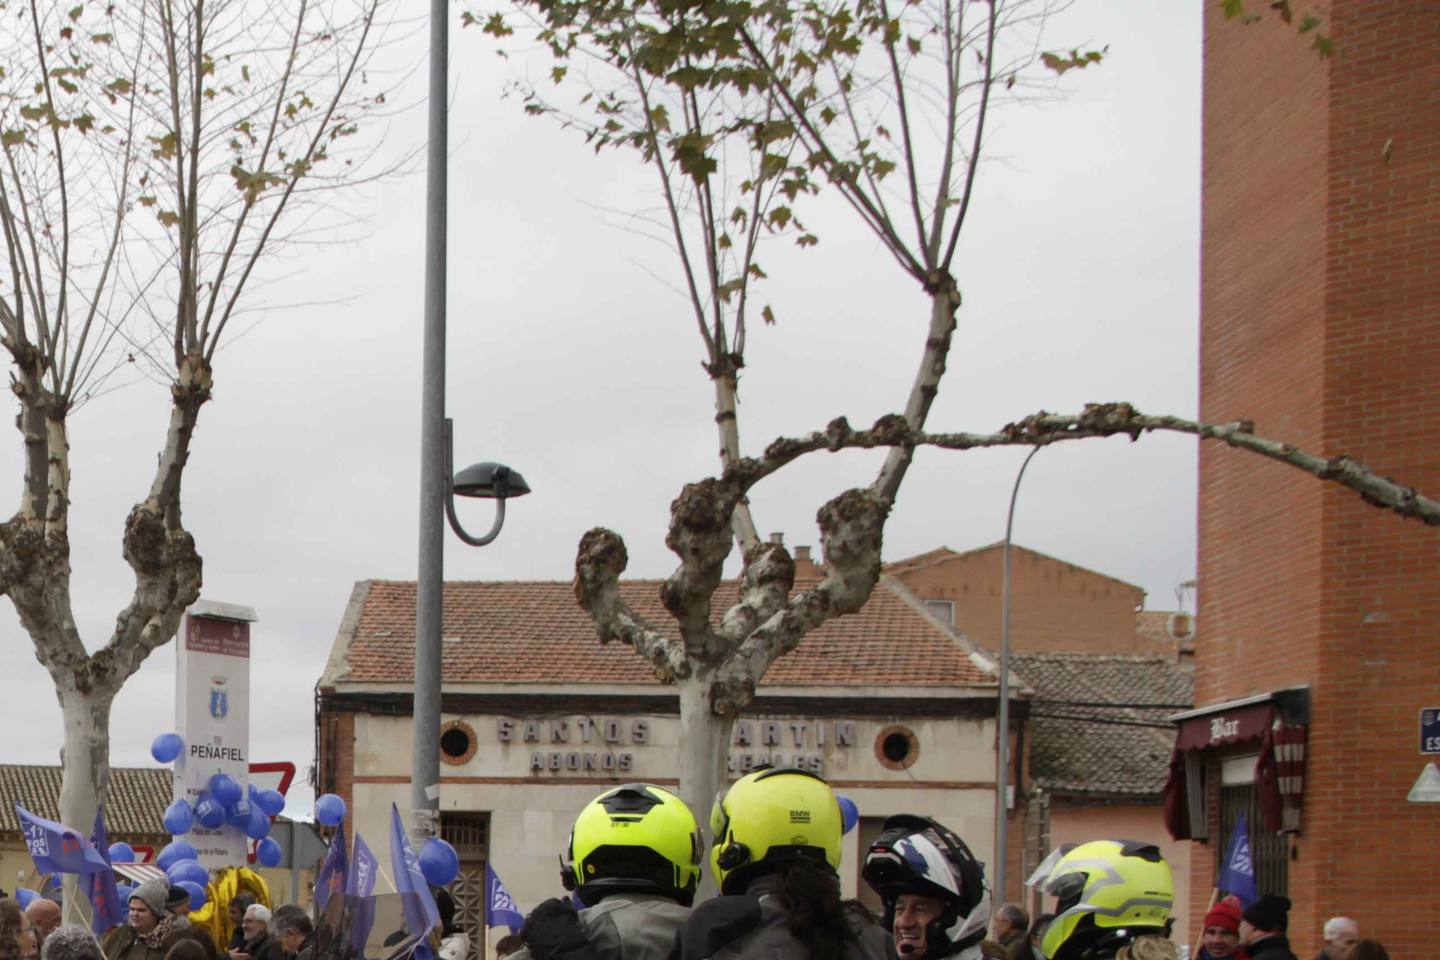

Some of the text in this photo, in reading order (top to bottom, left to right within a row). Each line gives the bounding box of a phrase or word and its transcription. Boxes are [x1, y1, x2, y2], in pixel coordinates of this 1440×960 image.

[498, 719, 856, 747] SANTOS ARTIN
[1210, 717, 1239, 743] Bar
[191, 743, 244, 761] PEÑAFIEL
[530, 752, 633, 772] ABONOS
[23, 824, 43, 838] -11
